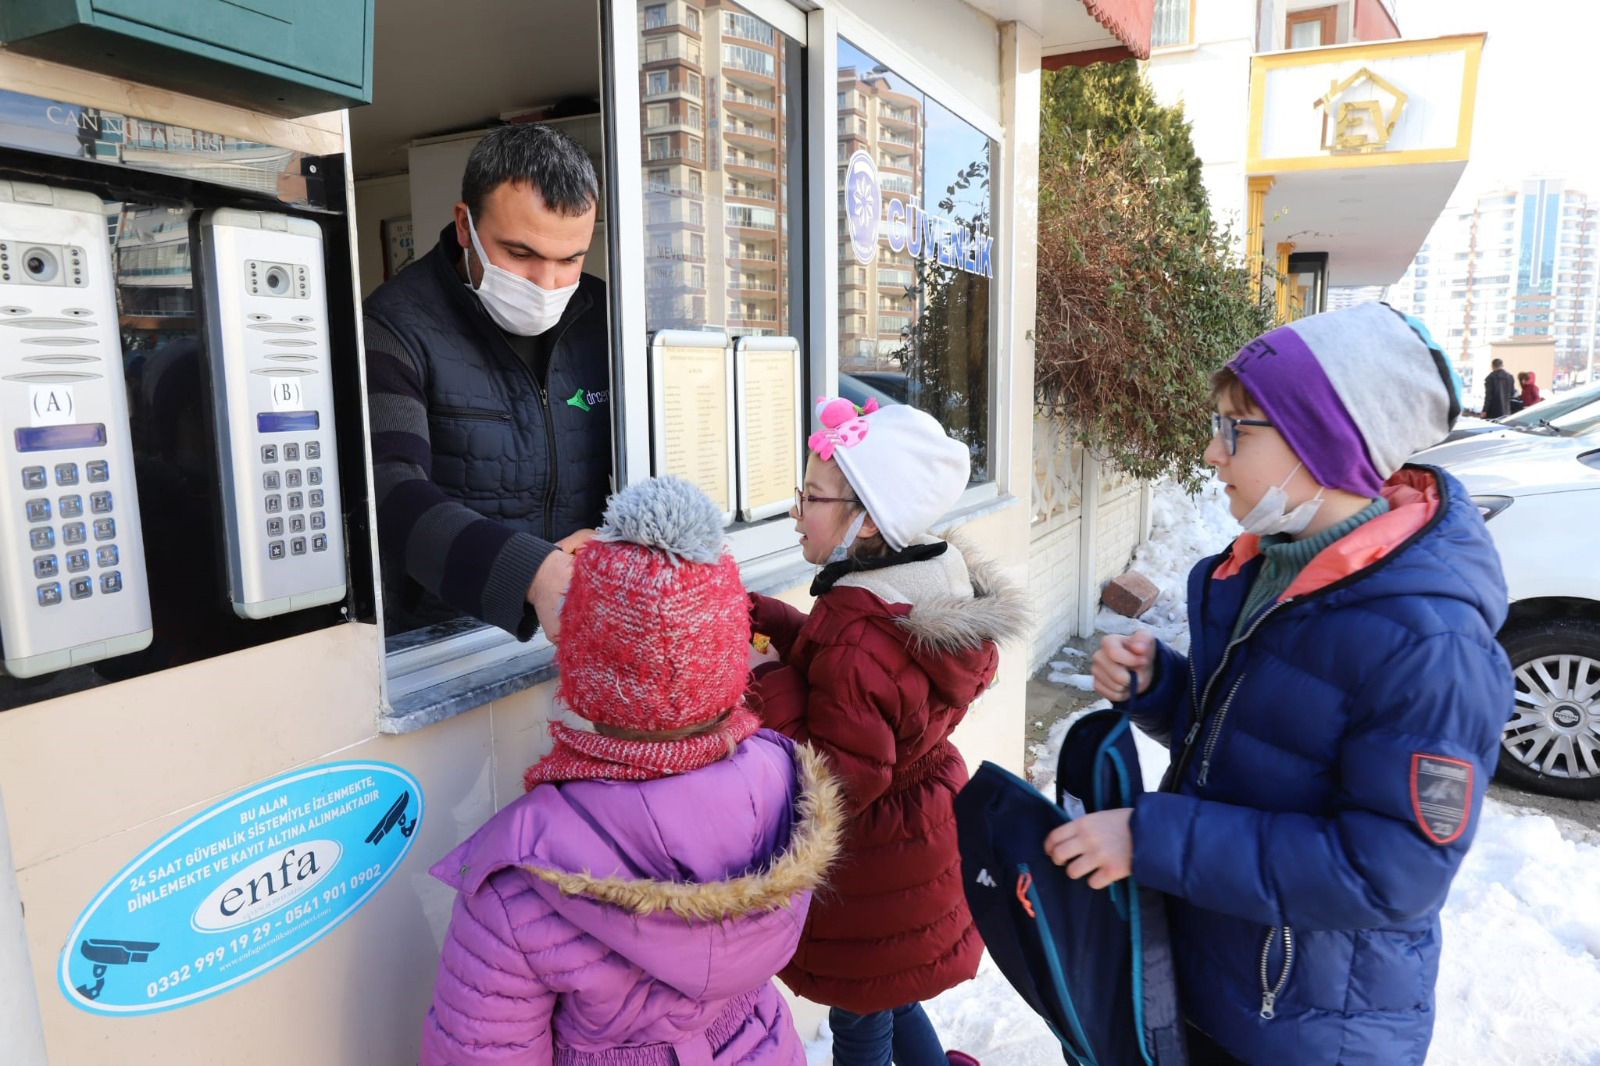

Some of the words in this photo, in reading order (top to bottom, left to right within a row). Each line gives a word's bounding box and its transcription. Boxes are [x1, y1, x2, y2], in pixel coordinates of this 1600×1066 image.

[887, 194, 994, 279] GÜVENLİK
[127, 865, 211, 913] DİNLEMEKTE
[213, 856, 229, 873] VE
[231, 841, 265, 865] KAYIT
[267, 825, 306, 849] ALTINA
[308, 789, 380, 831] ALINMAKTADIR
[130, 875, 146, 892] 24
[148, 858, 182, 884] SAAT
[185, 831, 245, 867] GÜVENLİK
[248, 802, 311, 839] SİSTEMİYLE
[313, 776, 376, 811] İZLENMEKTE,
[240, 808, 256, 825] BU
[258, 795, 288, 817] ALAN
[147, 964, 191, 998] 0332
[194, 946, 225, 973] 999
[230, 934, 248, 954] 19
[252, 922, 271, 943] 29
[285, 896, 319, 924] 0541
[323, 882, 346, 904] 901
[350, 863, 381, 889] 0902
[220, 849, 321, 917] enfa
